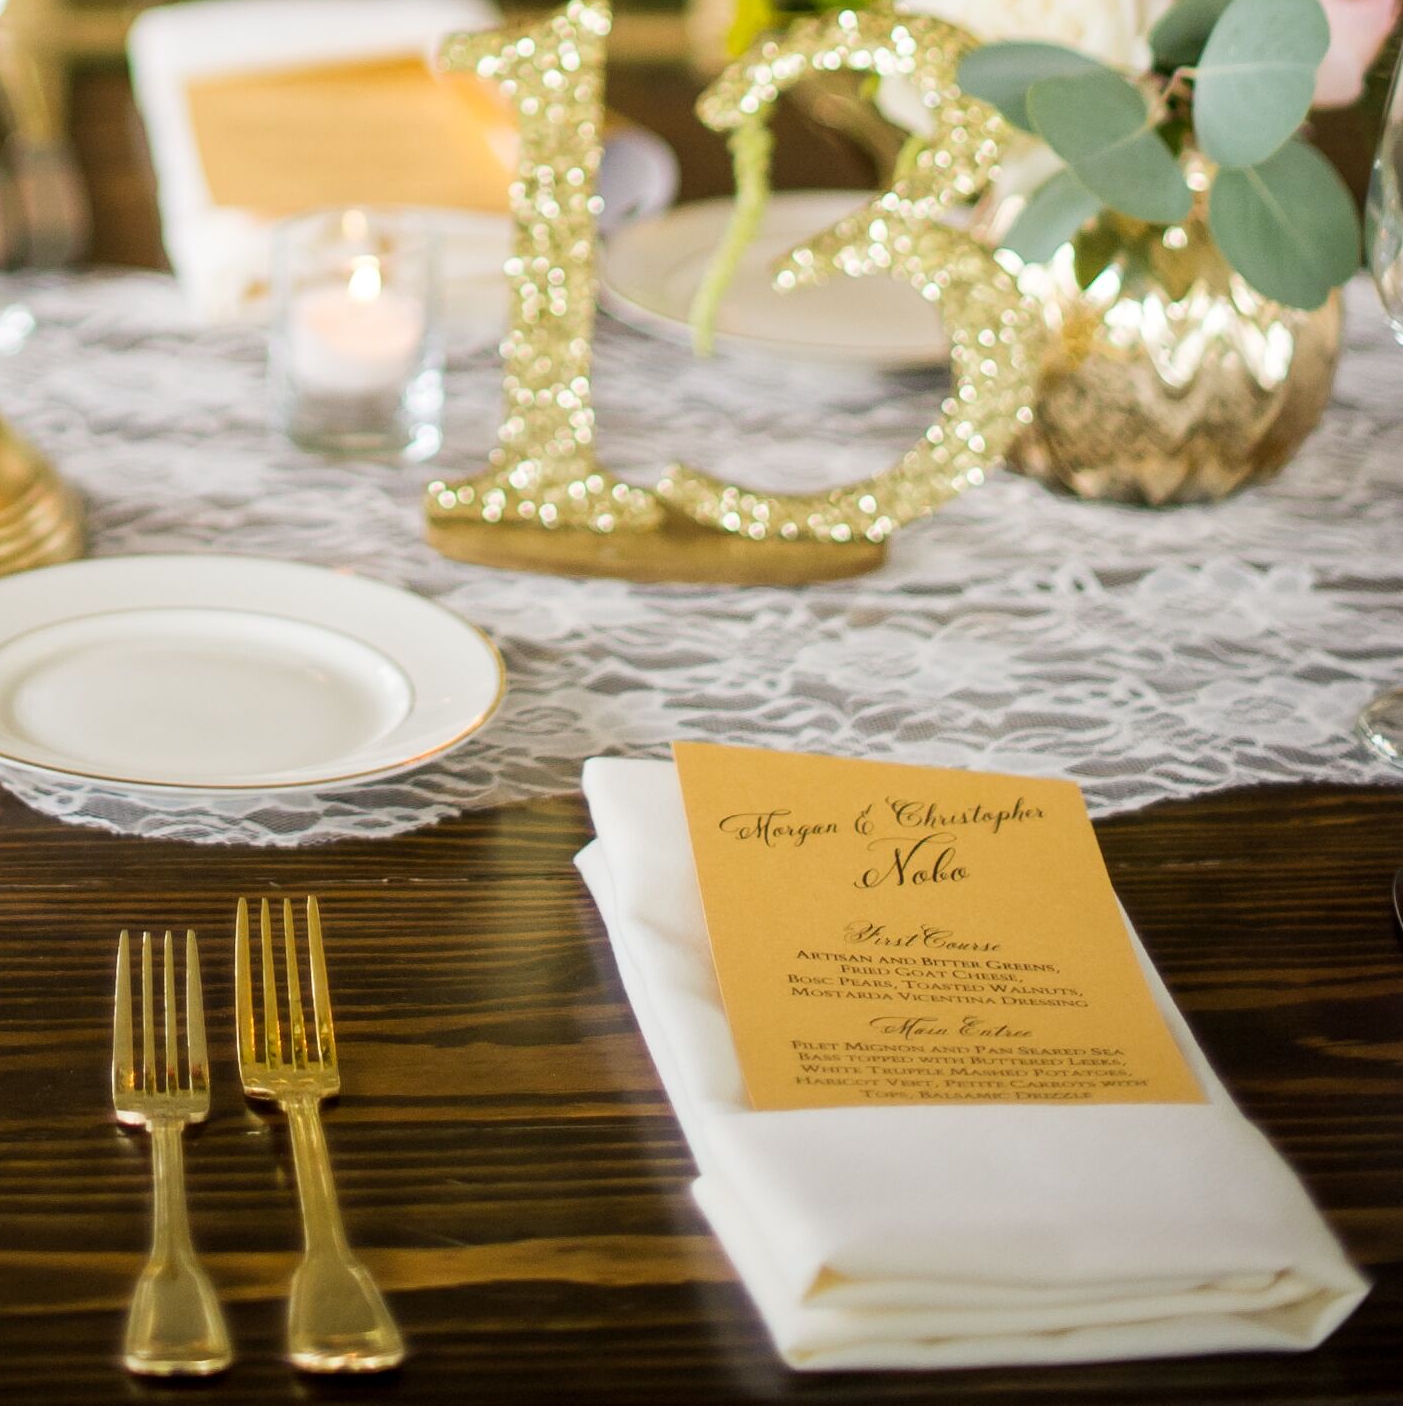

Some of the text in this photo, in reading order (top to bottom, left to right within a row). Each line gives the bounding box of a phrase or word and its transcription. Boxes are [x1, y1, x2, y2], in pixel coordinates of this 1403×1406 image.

[719, 808, 841, 847] Morgan
[884, 795, 1044, 834] Christopher
[853, 831, 971, 889] Nobo
[844, 919, 1001, 952] First Course
[797, 949, 872, 964] ARTISAN
[879, 955, 917, 966] AND
[921, 956, 981, 969] BITTER
[839, 963, 890, 976] FRIED
[894, 966, 947, 979] GOAT
[787, 973, 834, 985] BOSC
[901, 979, 985, 992] TOASTED
[1000, 995, 1089, 1009] DRESSING
[869, 1015, 1033, 1041] Main Entree
[790, 1039, 840, 1051] FILET
[845, 1041, 925, 1054] MIGNON
[930, 1045, 971, 1054] AND
[1090, 1047, 1125, 1057] SEA
[798, 1052, 841, 1063] BASS
[802, 1064, 862, 1075] WHITE
